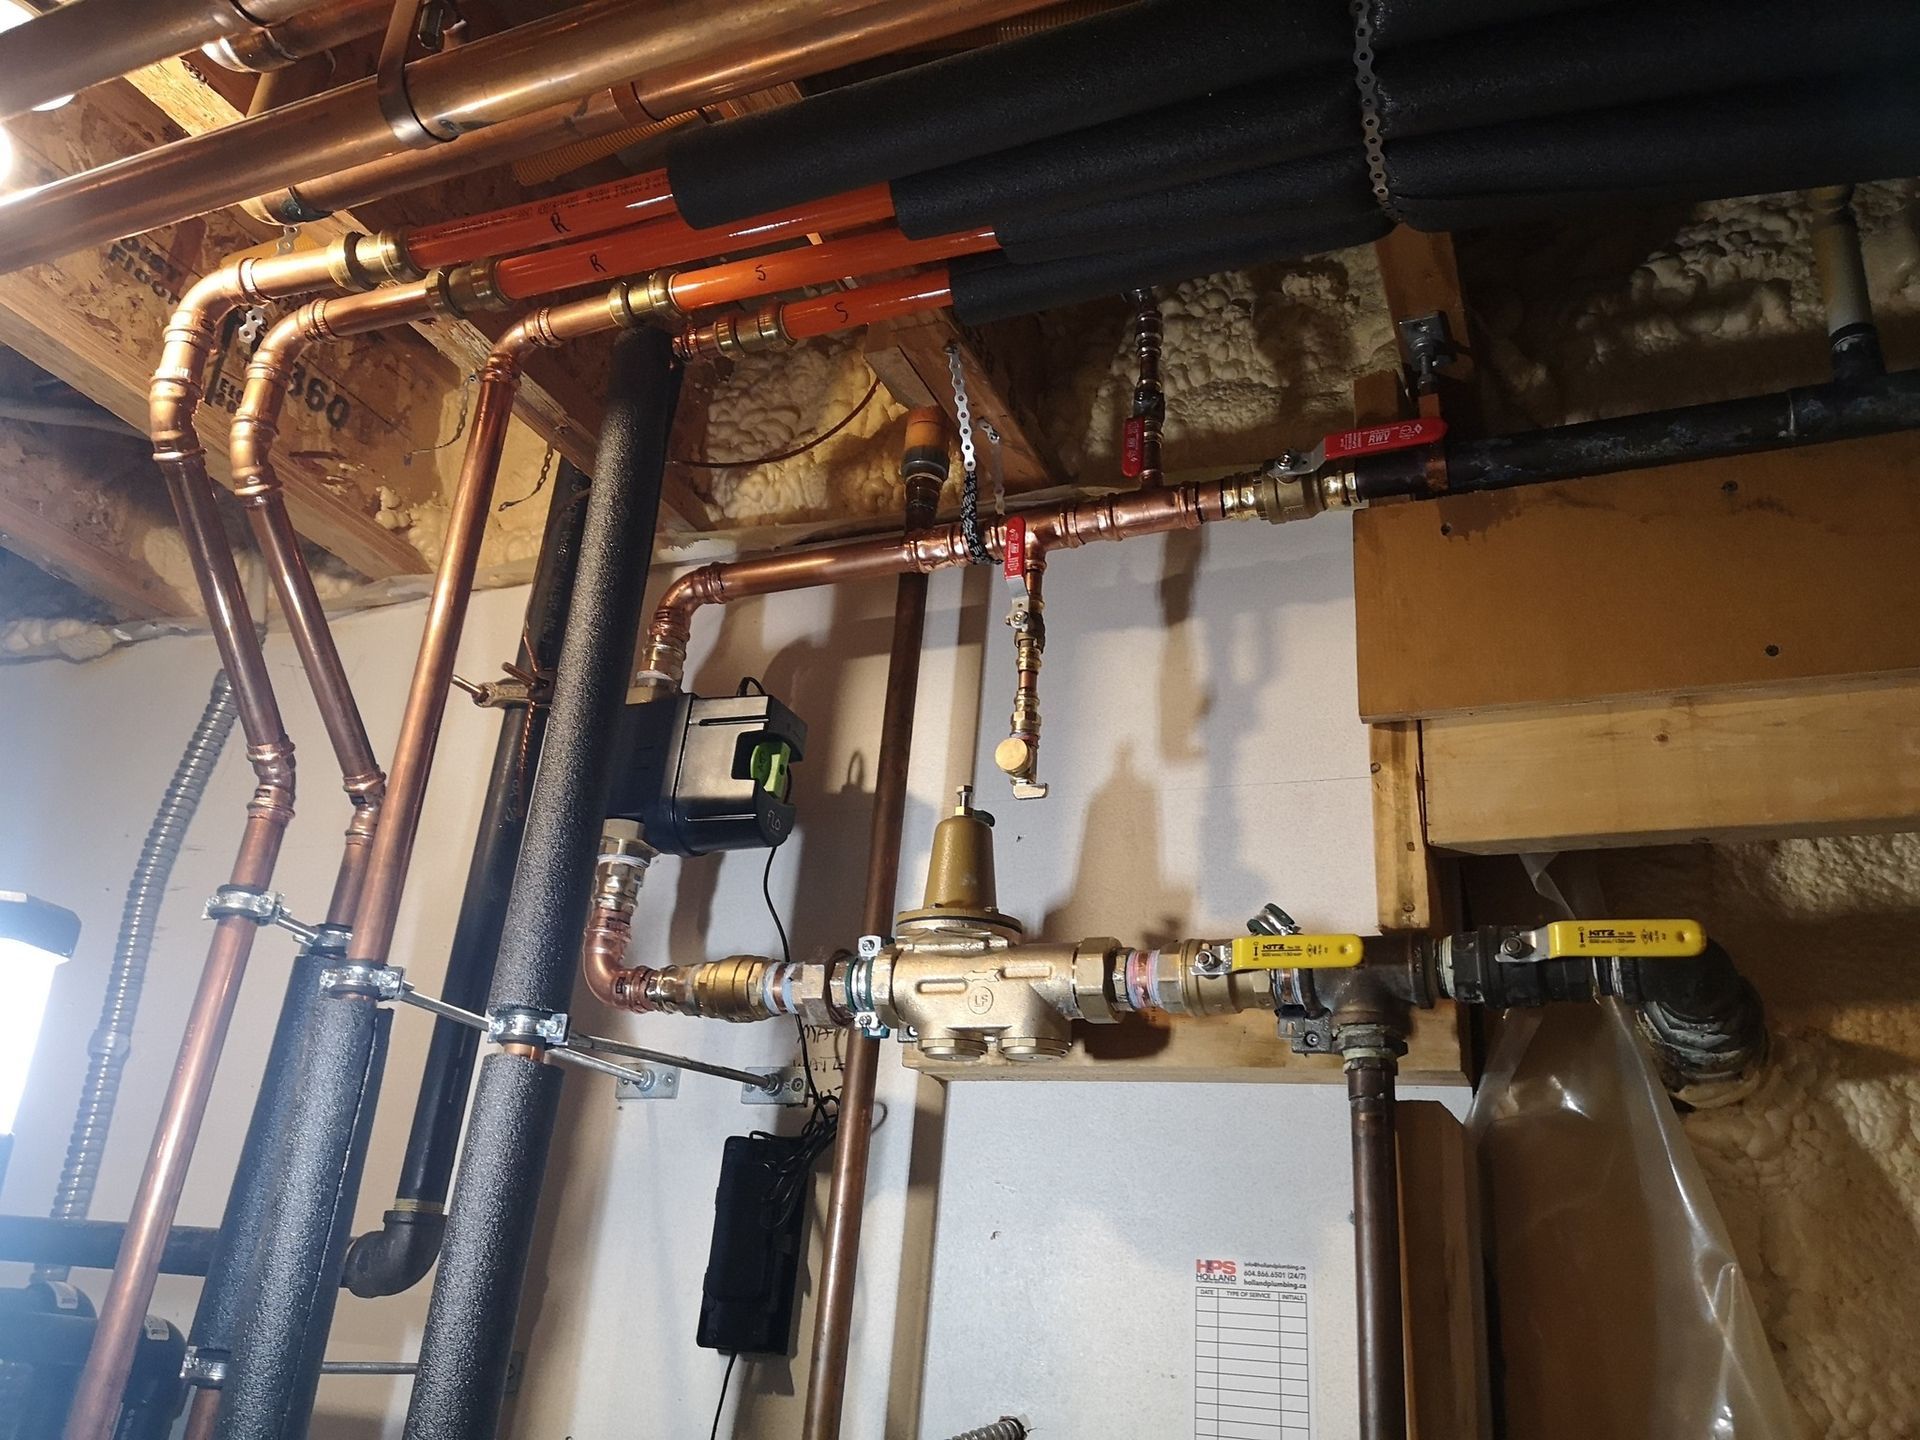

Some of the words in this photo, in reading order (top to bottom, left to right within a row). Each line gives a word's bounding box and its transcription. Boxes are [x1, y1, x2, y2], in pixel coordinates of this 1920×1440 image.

[550, 212, 569, 234] R
[589, 254, 607, 274] R
[834, 301, 849, 323] S
[1368, 431, 1391, 444] RWV
[1262, 943, 1285, 951] KITZ
[1195, 1258, 1237, 1274] HPS
[1195, 1273, 1237, 1282] HOLLAND
[1243, 1279, 1307, 1290] hollandplumbing.ca
